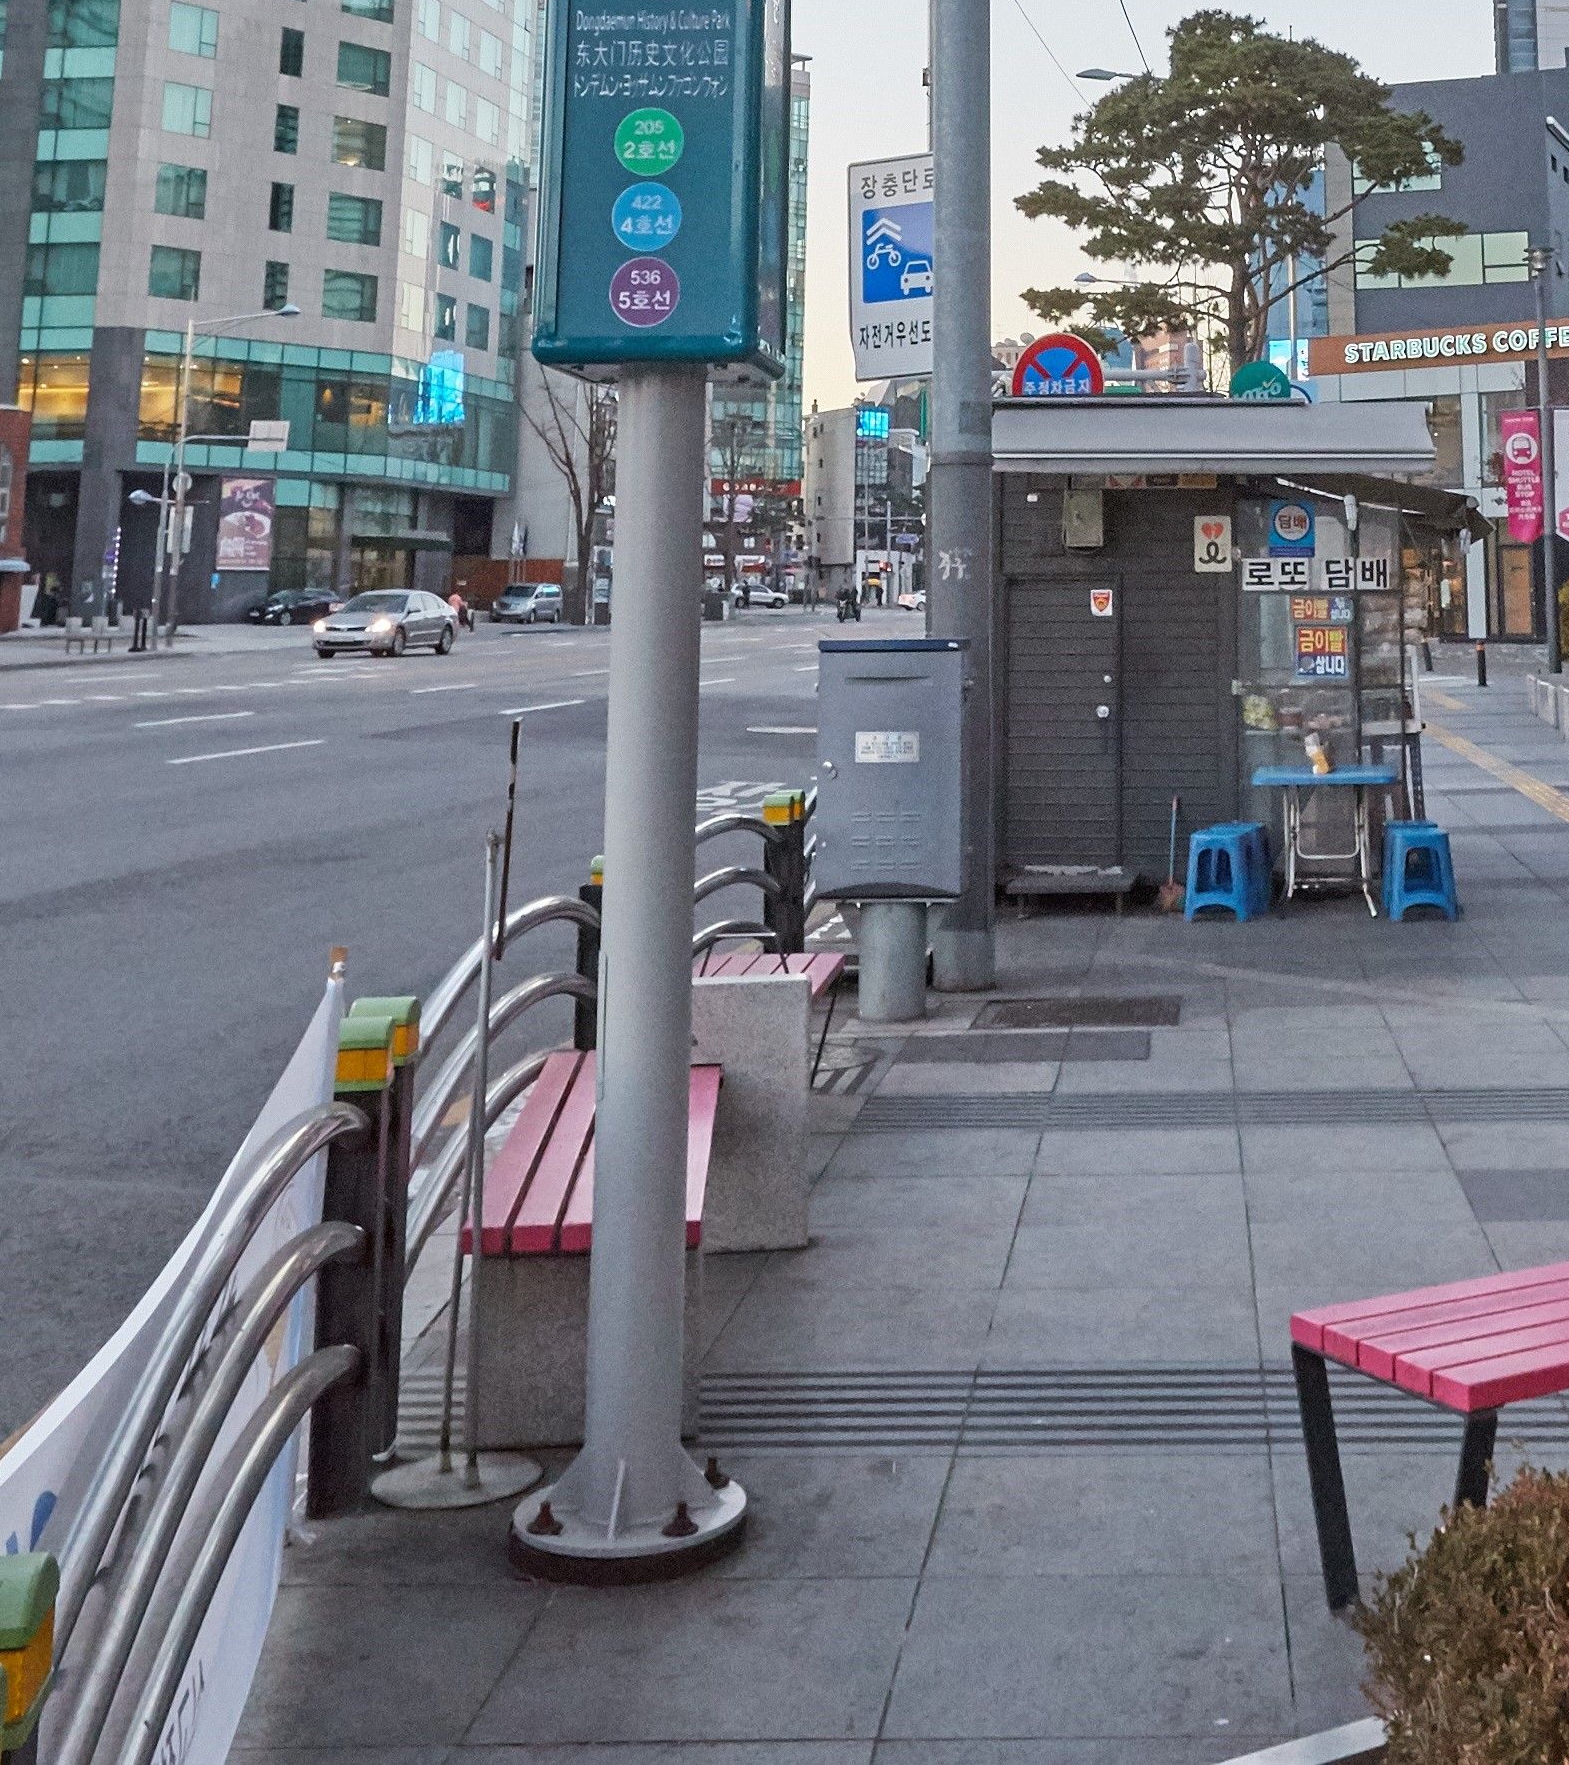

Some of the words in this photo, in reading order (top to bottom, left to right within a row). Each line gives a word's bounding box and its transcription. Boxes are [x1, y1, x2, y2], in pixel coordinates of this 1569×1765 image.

[634, 120, 664, 135] 205
[623, 140, 676, 160] 2호선
[632, 195, 662, 210] 422
[620, 215, 673, 235] 4호선
[630, 270, 661, 285] 536
[618, 290, 671, 311] 5호선
[859, 320, 932, 350] 자전거우선도
[1344, 332, 1488, 364] STARBUCKS
[1245, 561, 1307, 586] 로또
[1325, 558, 1388, 589] 담배
